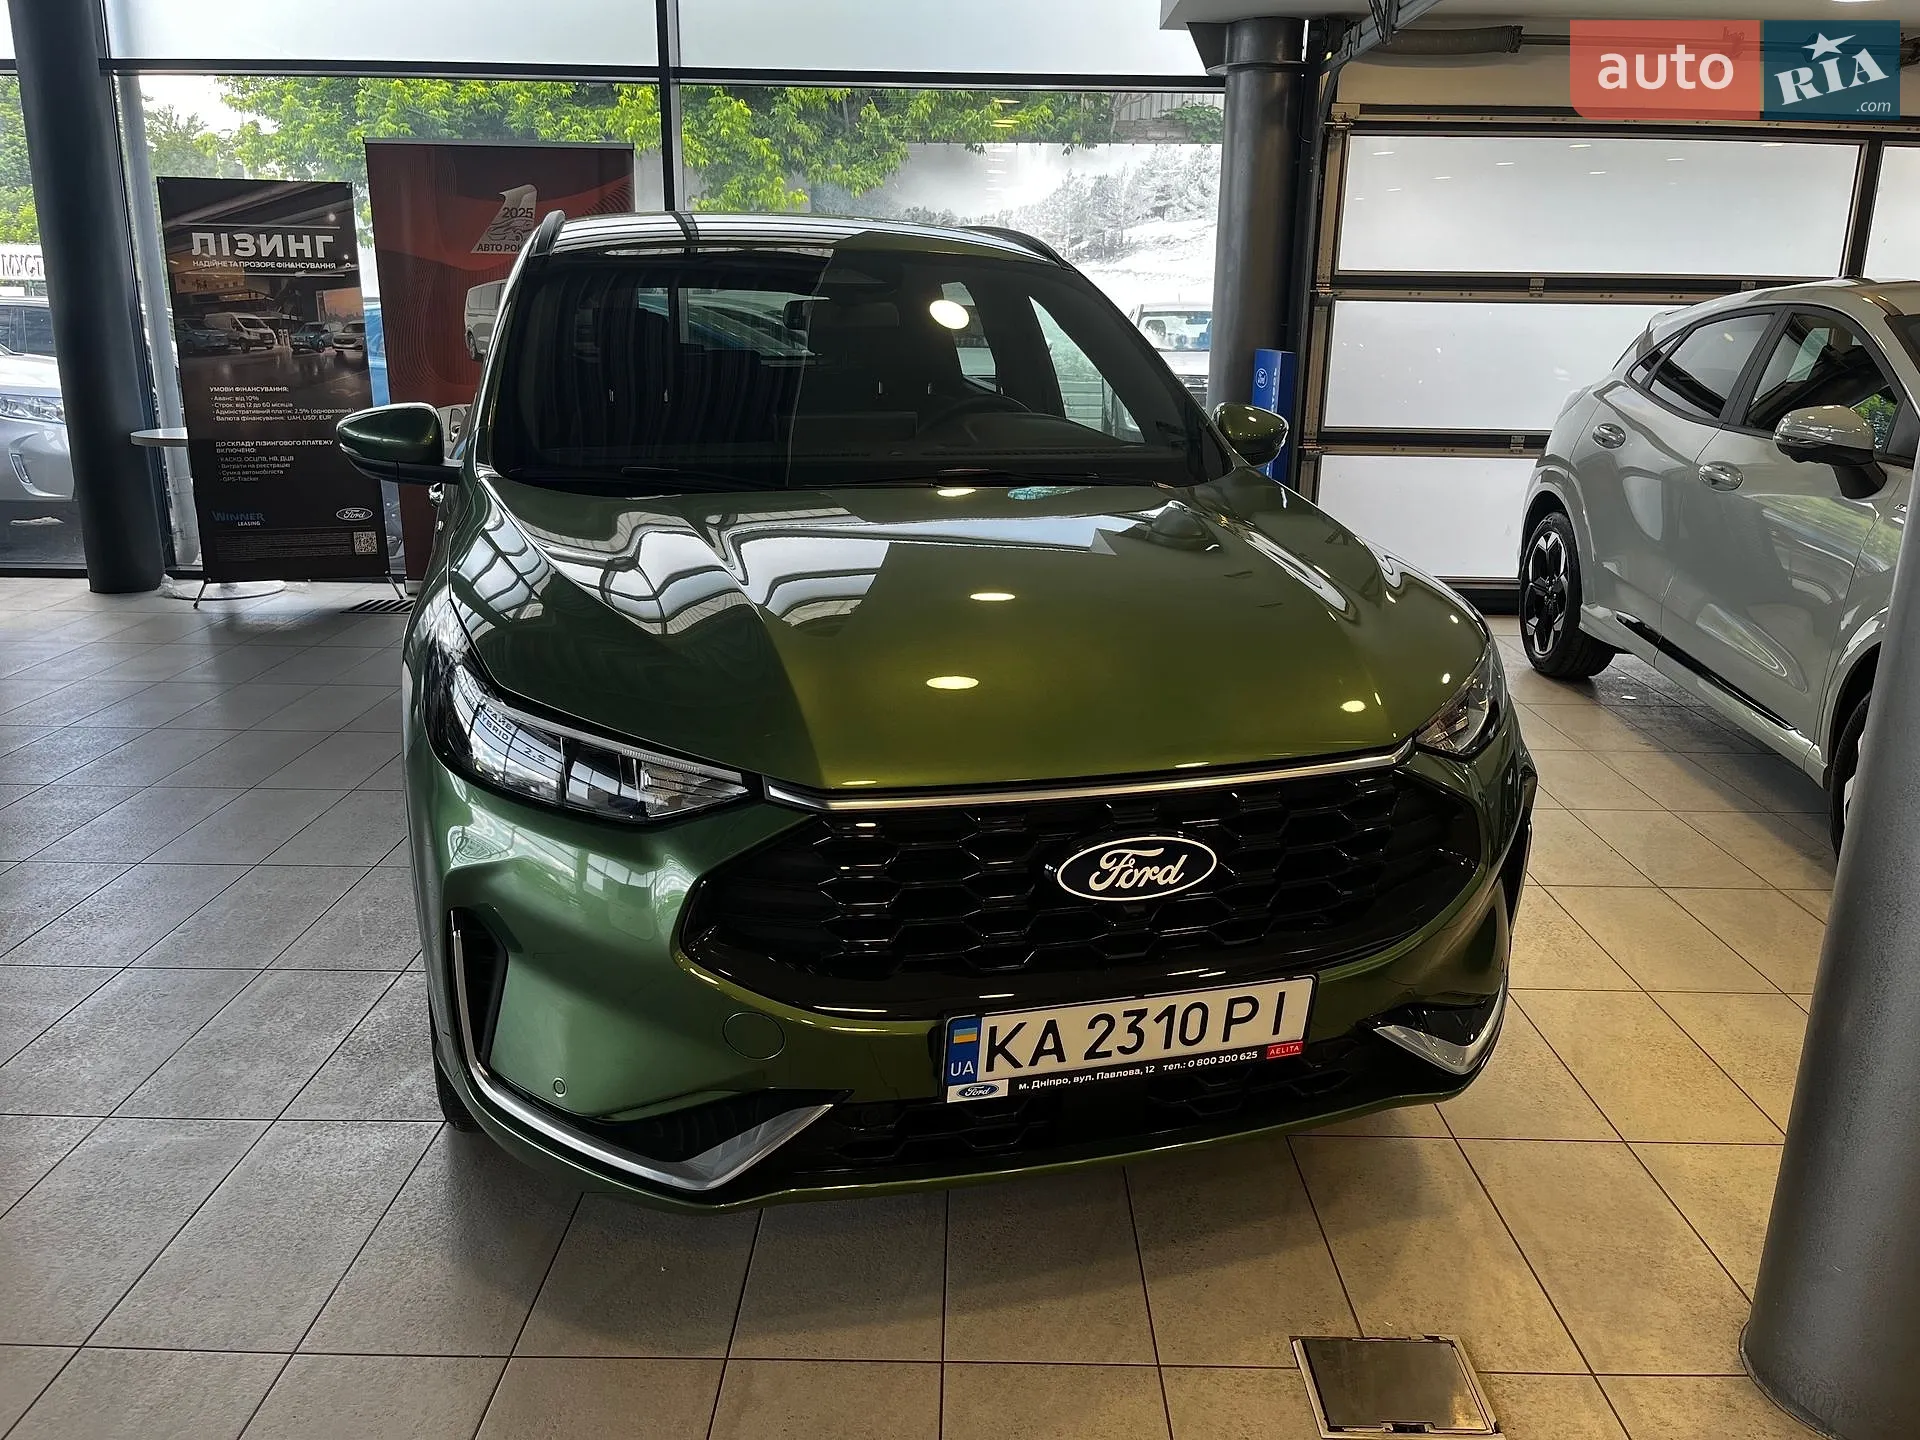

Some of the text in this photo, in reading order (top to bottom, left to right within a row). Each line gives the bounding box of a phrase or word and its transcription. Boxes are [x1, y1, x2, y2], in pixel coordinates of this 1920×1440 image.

[502, 207, 534, 219] 2025
[191, 232, 334, 258] ЛІЗИНГ
[477, 244, 503, 252] АВТО
[192, 259, 227, 268] НАДІЙНЕ
[343, 509, 366, 519] Ford
[1089, 848, 1188, 891] Ford
[950, 1060, 975, 1076] UA
[985, 1018, 1067, 1073] KA
[1083, 1001, 1209, 1061] 2310
[1269, 1045, 1300, 1056] AELITA
[1031, 1077, 1072, 1090] Дніпро,
[1073, 1075, 1095, 1084] вул.
[1096, 1065, 1144, 1080] Павлова,
[1145, 1065, 1155, 1074] 12
[1162, 1061, 1187, 1071] тел.:
[1187, 1059, 1195, 1068] 0
[1196, 1055, 1217, 1066] 800
[1218, 1053, 1238, 1064] 300
[1239, 1050, 1258, 1061] 625
[964, 1085, 990, 1098] Ford
